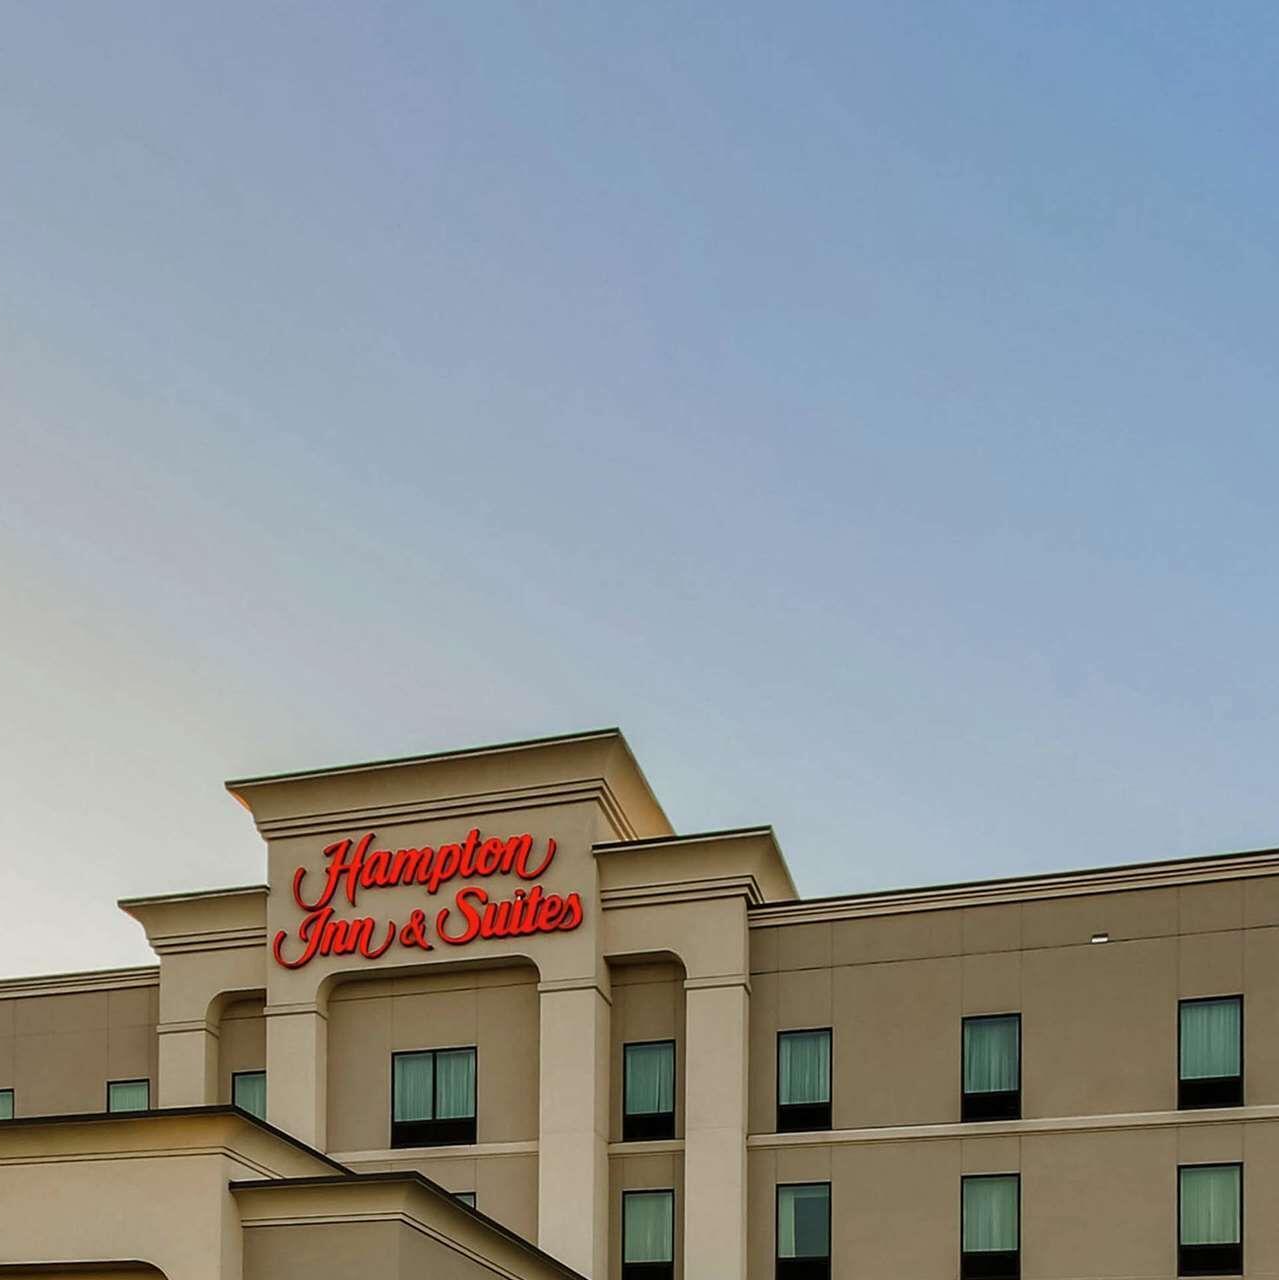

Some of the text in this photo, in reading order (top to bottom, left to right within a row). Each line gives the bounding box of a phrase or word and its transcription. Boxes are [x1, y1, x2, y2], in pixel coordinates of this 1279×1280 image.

[293, 828, 557, 912] Hampton
[273, 886, 584, 969] Inn & Suites
